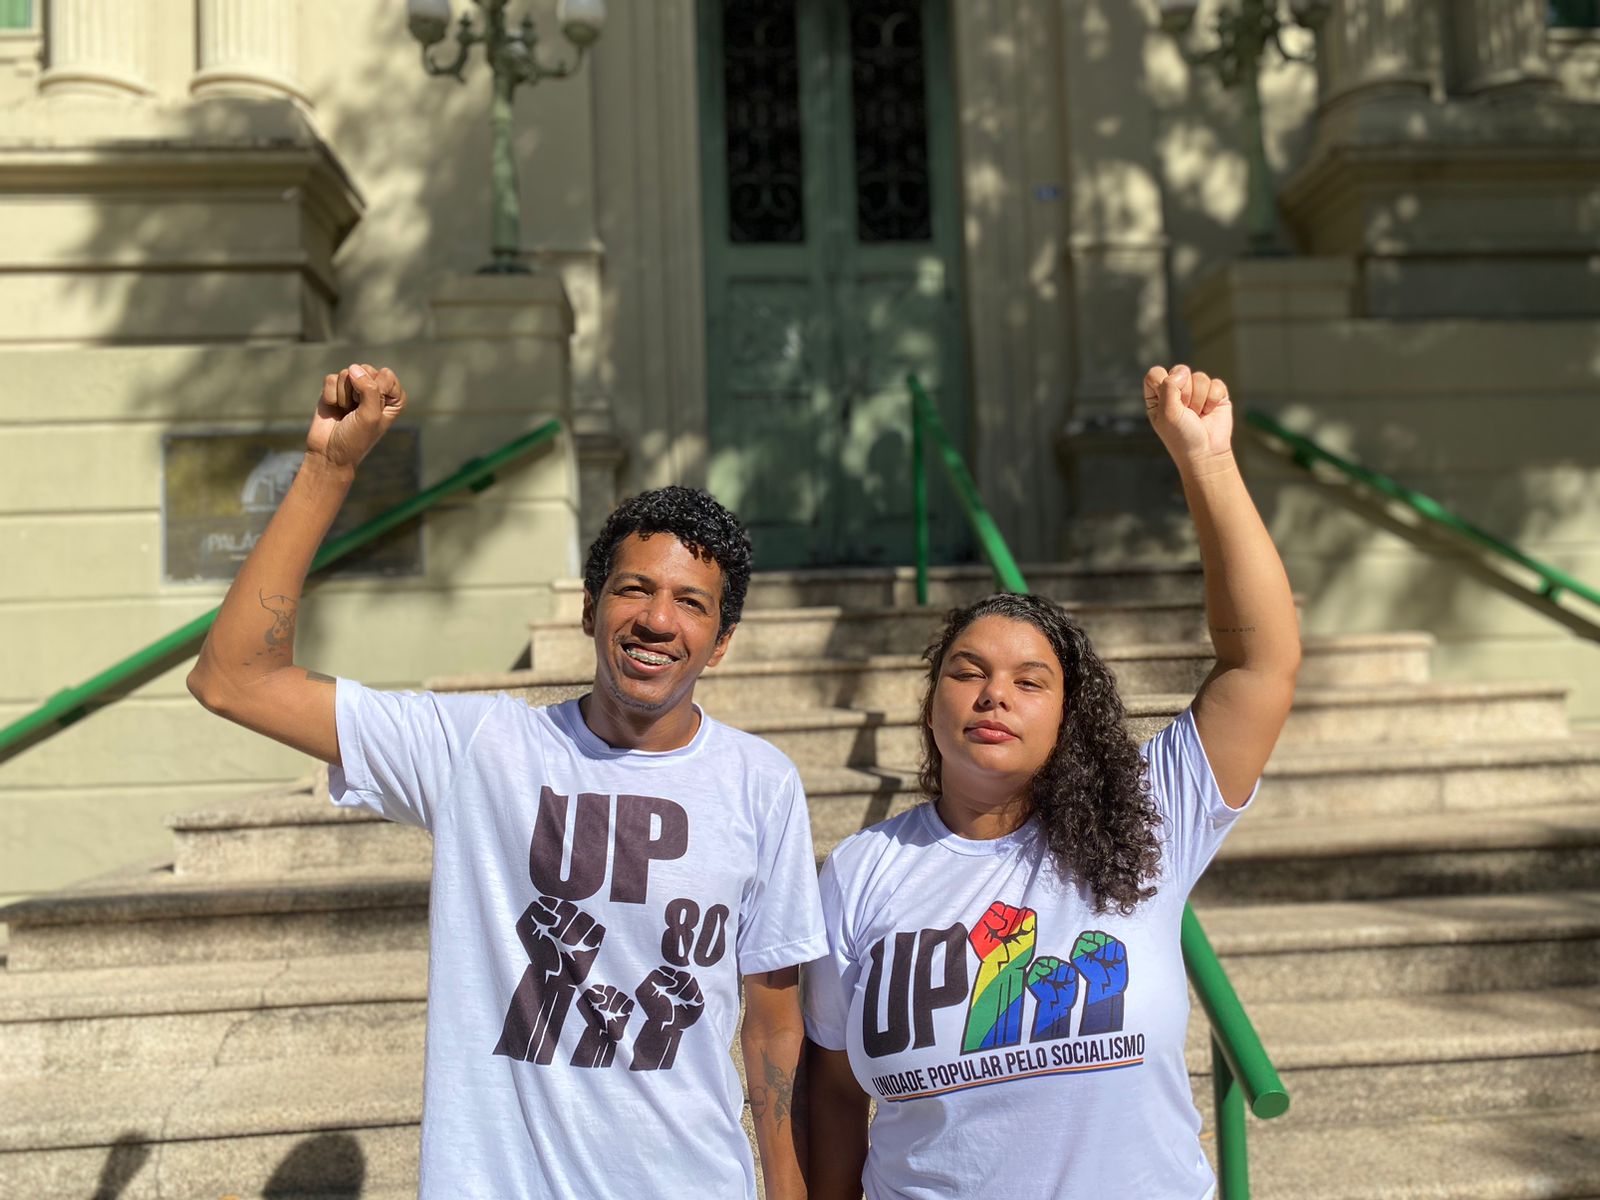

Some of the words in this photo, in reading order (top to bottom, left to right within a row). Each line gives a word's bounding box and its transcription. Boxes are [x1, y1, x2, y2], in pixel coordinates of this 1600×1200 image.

[529, 785, 688, 904] UP
[661, 898, 729, 967] 80
[863, 922, 968, 1058] UP
[872, 1069, 928, 1096] UNIDADE
[927, 1055, 1003, 1088] POPULAR
[1005, 1047, 1048, 1074] PELO
[1051, 1033, 1145, 1066] SOCIALISMO
